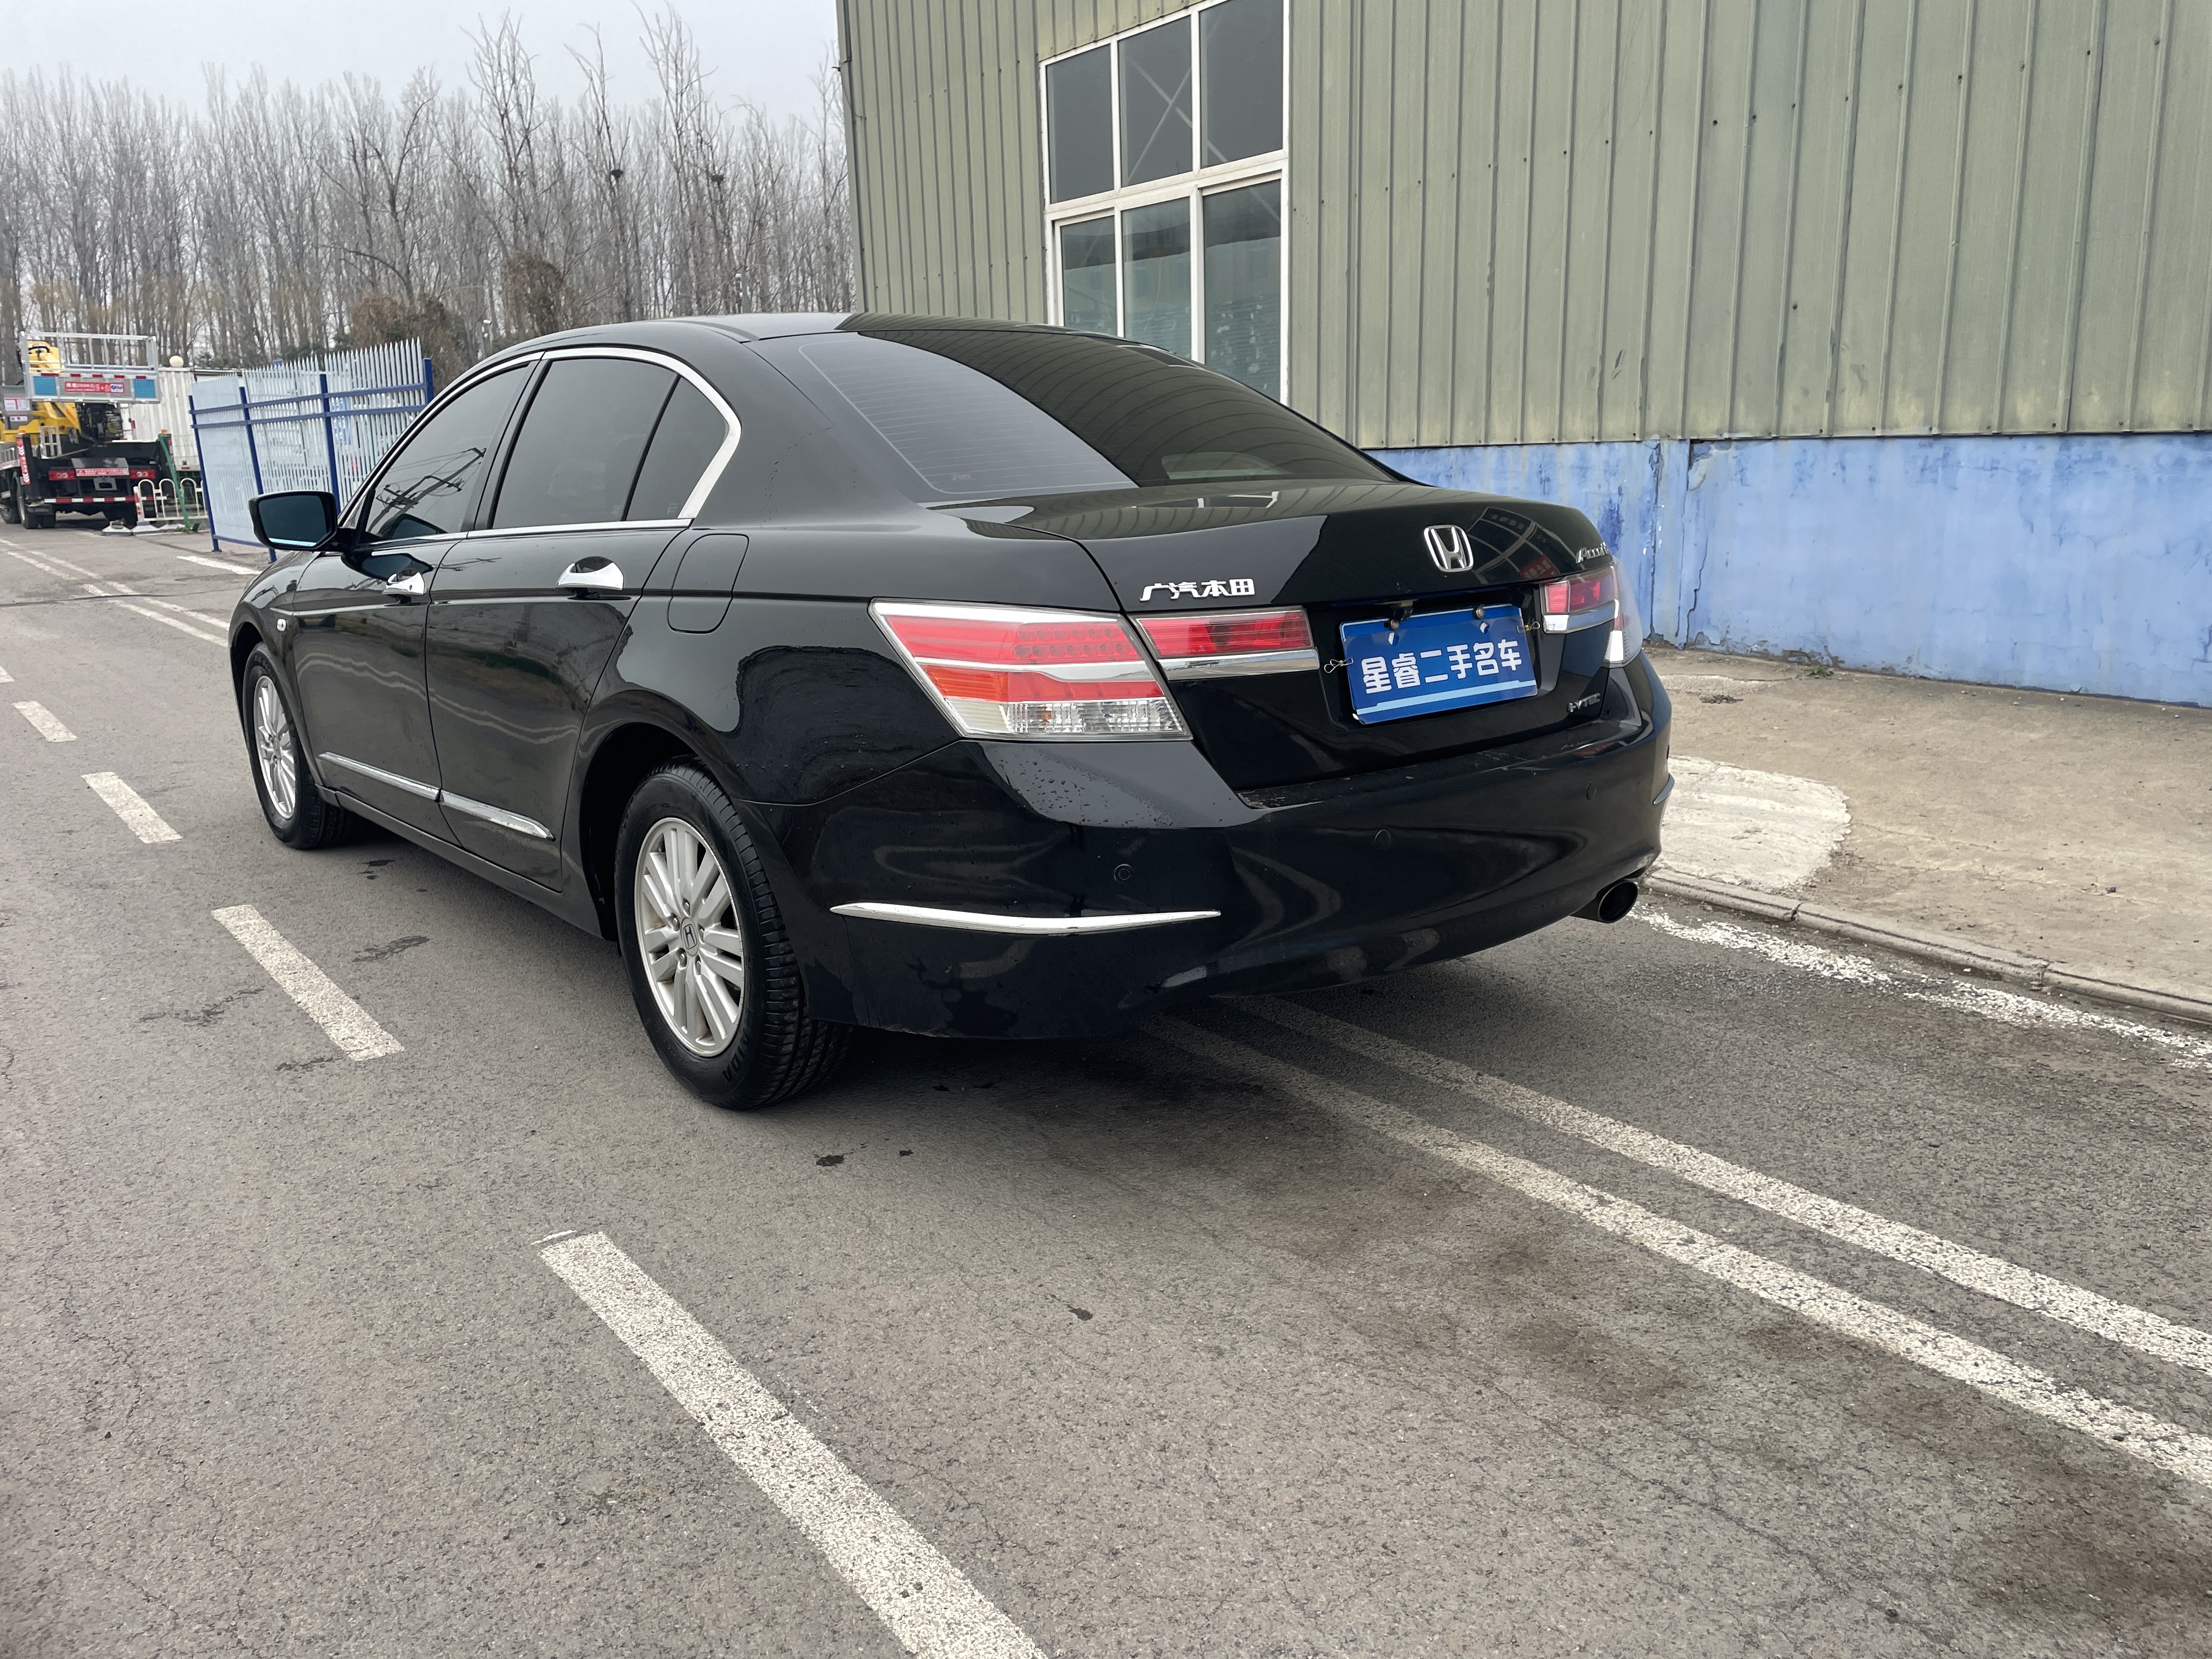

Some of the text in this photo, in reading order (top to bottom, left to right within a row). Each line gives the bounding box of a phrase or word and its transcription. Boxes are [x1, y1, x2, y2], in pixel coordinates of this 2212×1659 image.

[1139, 578, 1255, 602] 广汽本田
[1361, 639, 1522, 694] 星睿二手名车
